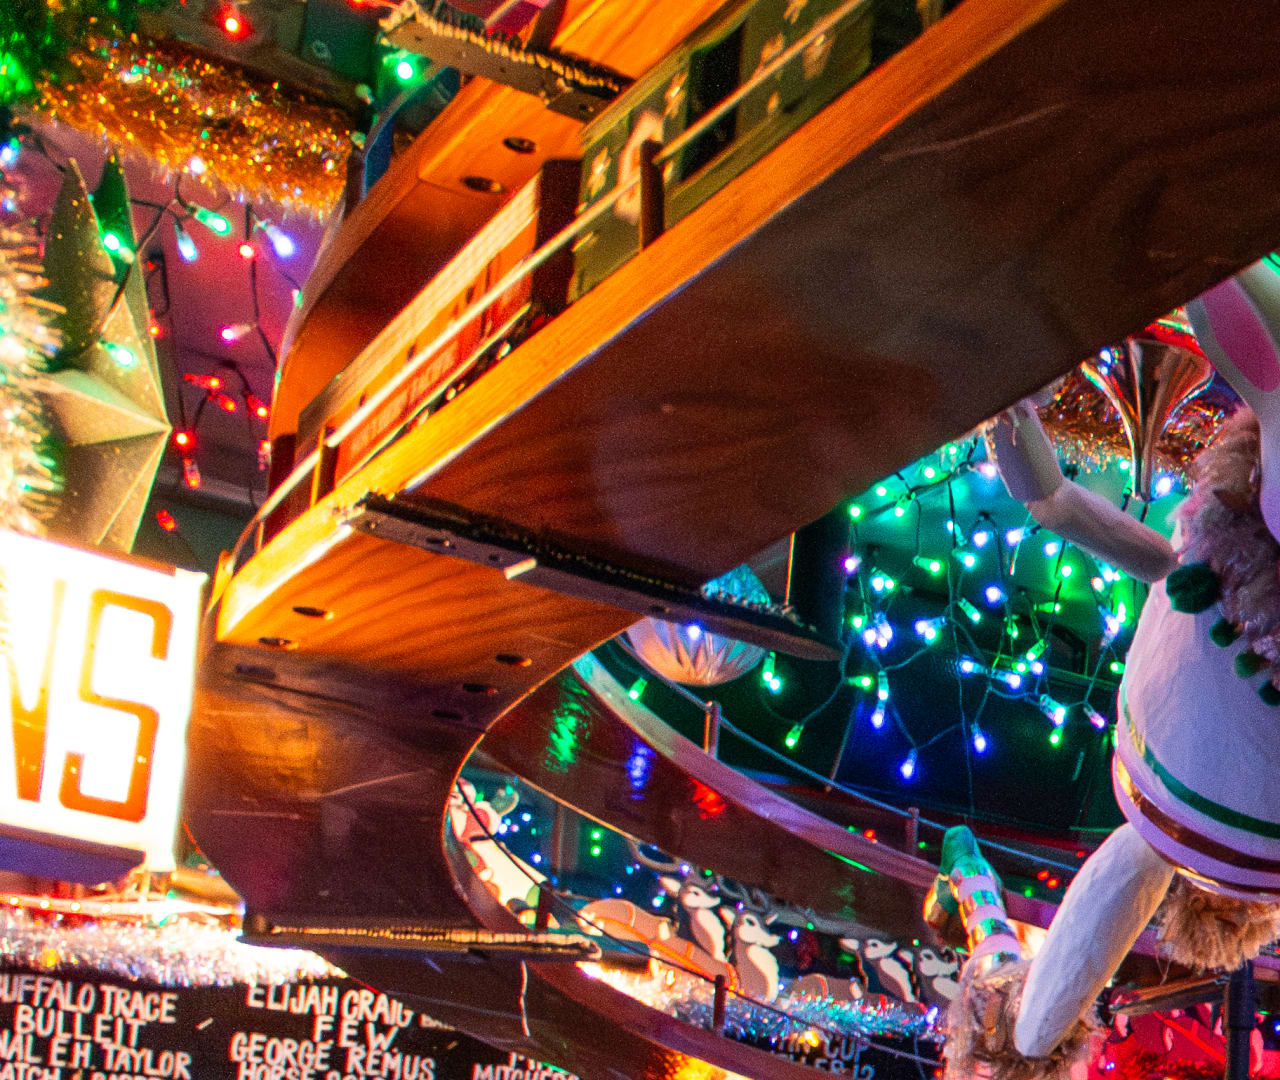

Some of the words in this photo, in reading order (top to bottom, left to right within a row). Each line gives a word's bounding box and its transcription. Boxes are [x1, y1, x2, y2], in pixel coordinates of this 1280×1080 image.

[99, 984, 178, 1023] TRACE
[247, 983, 339, 1015] ELIJAH
[340, 989, 414, 1028] CRAIG
[14, 1004, 146, 1049] BULLEIT
[101, 1041, 192, 1080] TAYLOR
[229, 1032, 334, 1071] GEORGE
